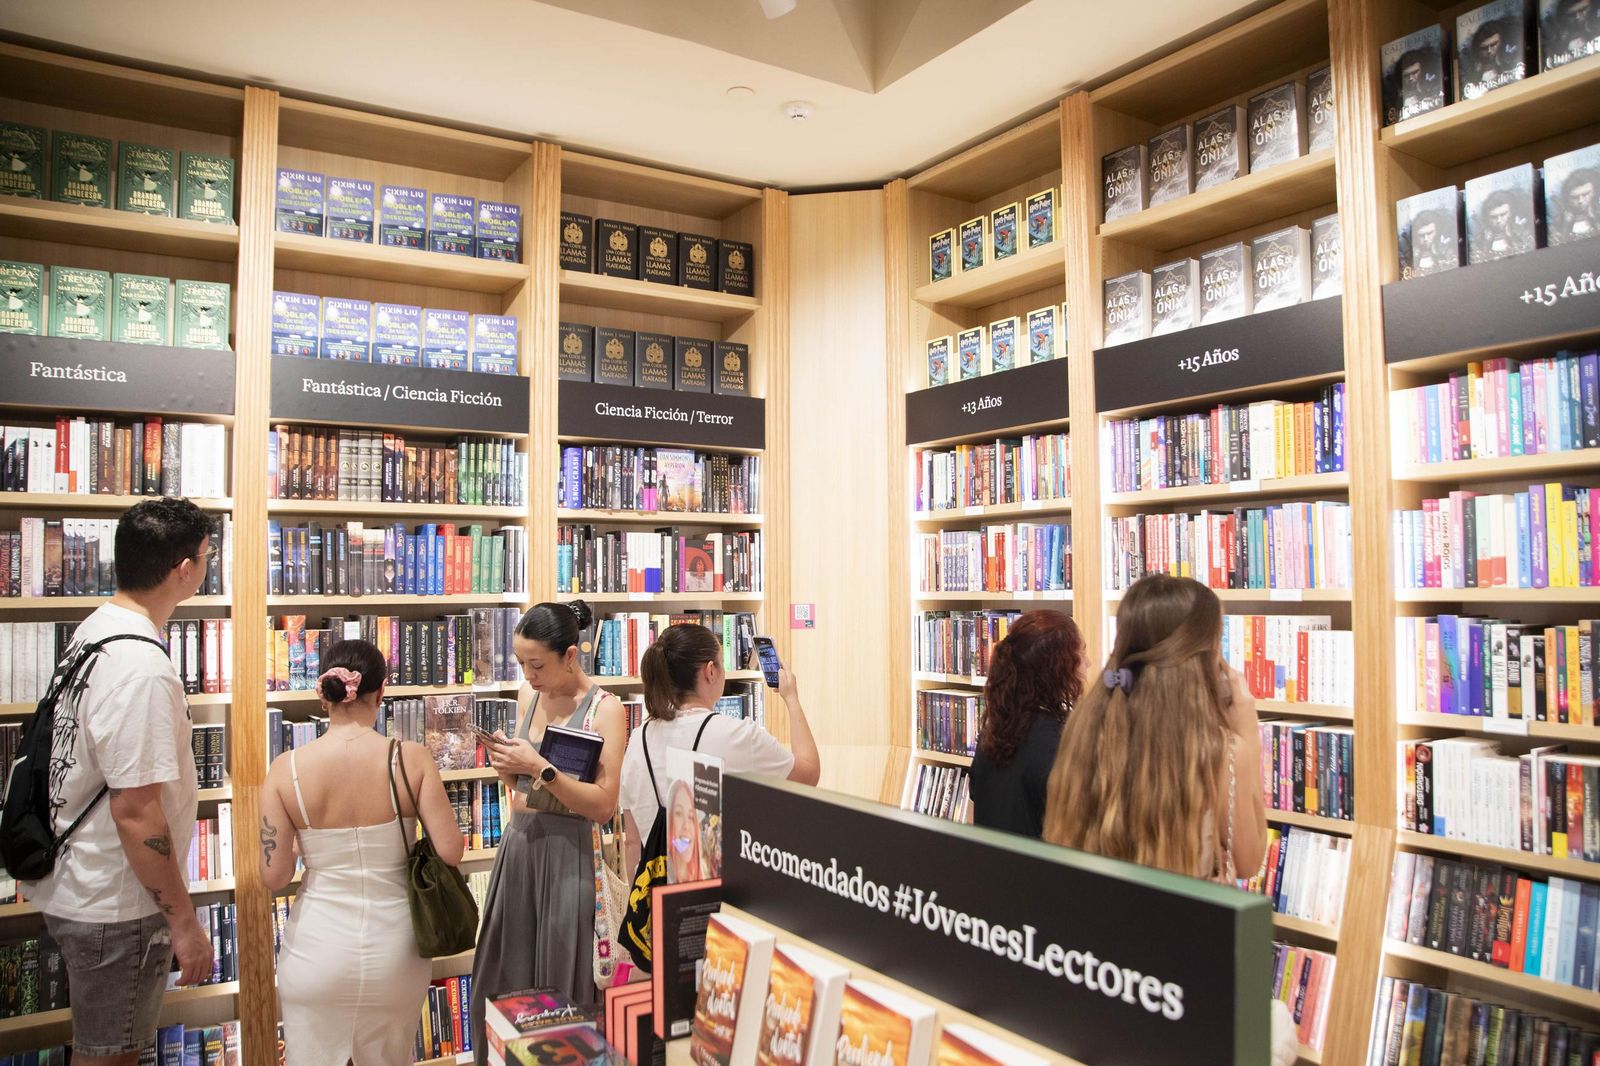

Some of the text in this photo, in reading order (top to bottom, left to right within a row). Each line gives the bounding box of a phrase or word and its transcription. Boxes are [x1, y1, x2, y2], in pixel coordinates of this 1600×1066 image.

[1198, 132, 1223, 151] ALAS
[1151, 151, 1174, 167] ALAS
[1200, 144, 1229, 166] ÓNIX
[280, 171, 321, 183] CIXIN LIU
[331, 181, 355, 189] CIXIN
[1106, 169, 1127, 185] ALAS
[385, 188, 423, 198] CIXIN LIU
[435, 197, 457, 205] CIXIN
[481, 204, 502, 212] CIXIN
[1316, 239, 1340, 255] ALA
[1256, 255, 1285, 272] ALAS
[0, 267, 33, 278] RENZA
[1204, 269, 1230, 286] ALAS
[1154, 283, 1178, 299] ALAS
[1519, 272, 1600, 306] +15 Añ
[276, 295, 300, 304] CIXIN
[328, 301, 367, 311] CIXIN LIU
[1107, 294, 1130, 309] ALAS
[380, 306, 417, 316] CIXIN LIU
[428, 312, 466, 321] CIXIN LIU
[478, 317, 499, 325] CIXIN
[1178, 348, 1240, 373] +15 Años
[30, 361, 128, 383] Fantástica
[301, 378, 382, 398] Fantástica
[392, 386, 448, 403] Ciencia
[450, 390, 503, 407] Ficción
[962, 395, 1003, 415] +13 Años
[595, 402, 642, 419] Ciencia
[644, 406, 689, 422] Ficción
[696, 411, 735, 426] Terror
[433, 705, 467, 715] TOLKIEN
[739, 829, 1185, 1021] Recomendados #JóvenesLectores
